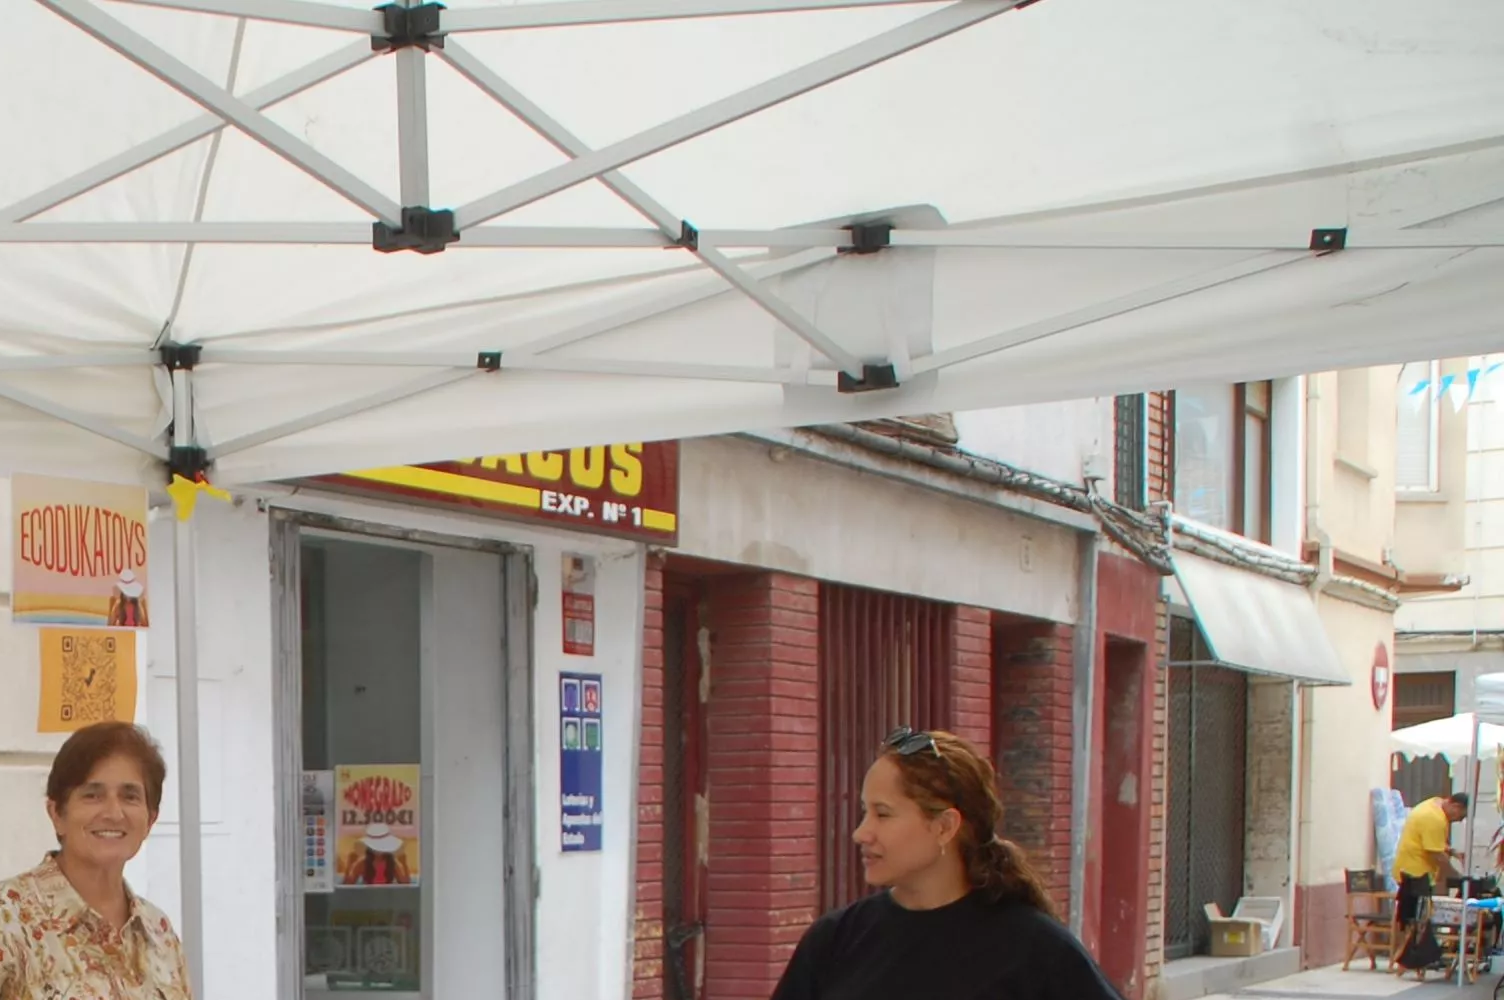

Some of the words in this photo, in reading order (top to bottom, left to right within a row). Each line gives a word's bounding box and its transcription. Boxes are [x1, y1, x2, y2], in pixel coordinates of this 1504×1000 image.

[542, 490, 594, 518] EXP.
[631, 506, 642, 526] 1
[21, 504, 146, 577] ECODUKATOYS
